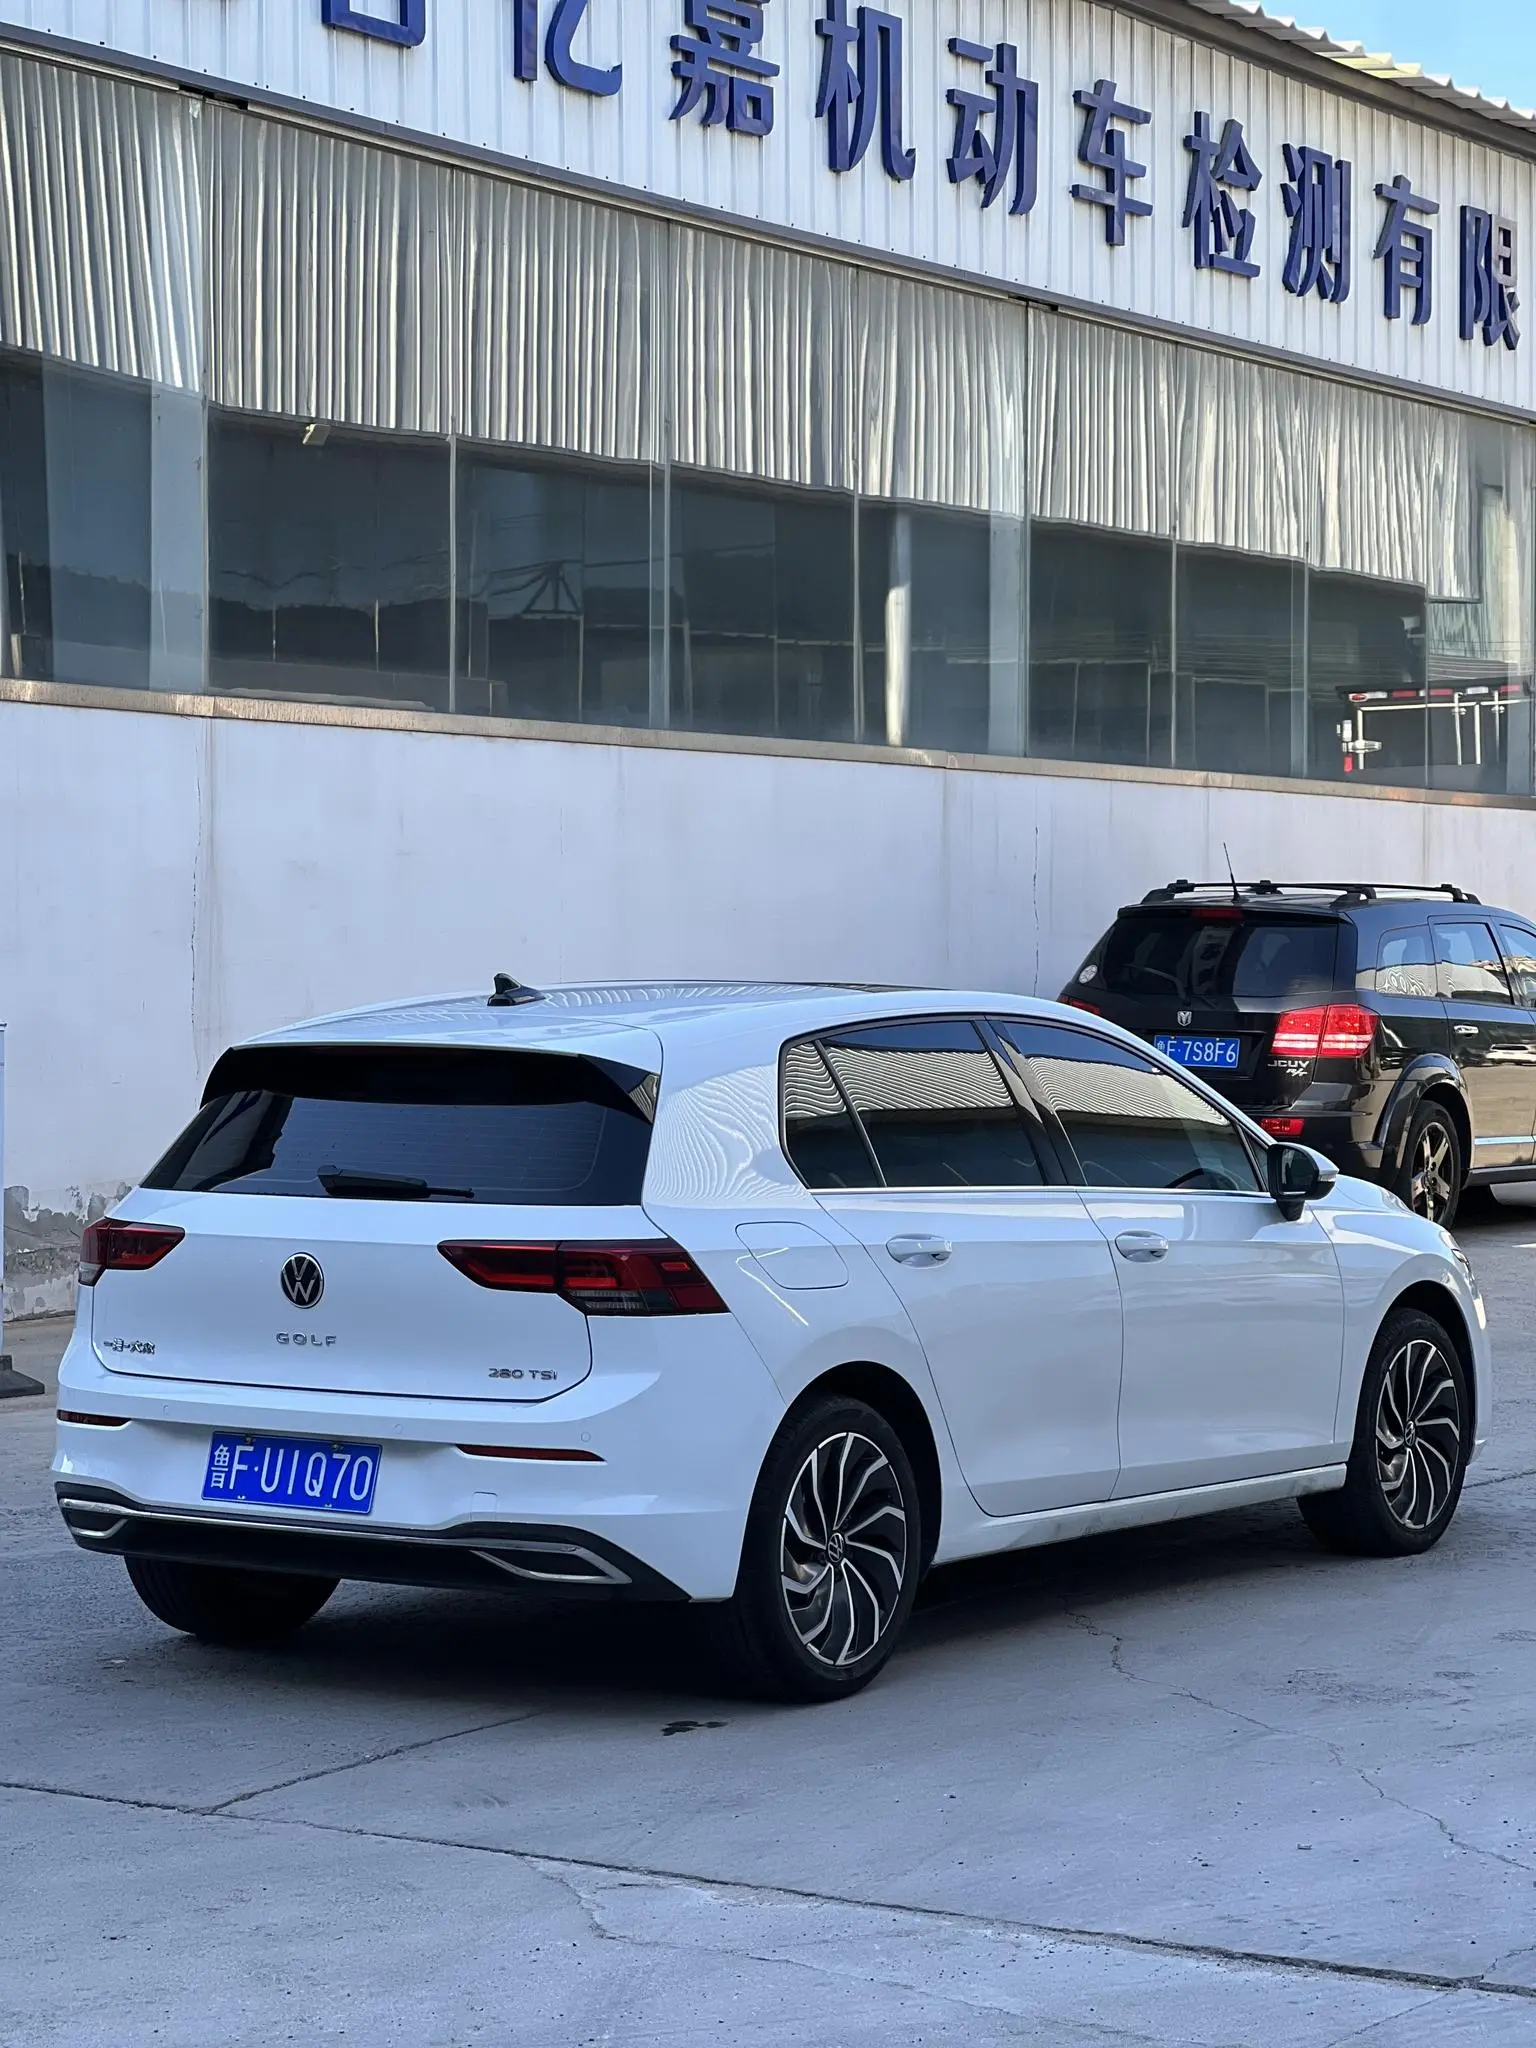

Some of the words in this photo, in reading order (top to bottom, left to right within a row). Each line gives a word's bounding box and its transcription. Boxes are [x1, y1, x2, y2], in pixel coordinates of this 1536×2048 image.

[321, 0, 1521, 352] 嘉机动车检测有限
[276, 1331, 337, 1346] GOLF
